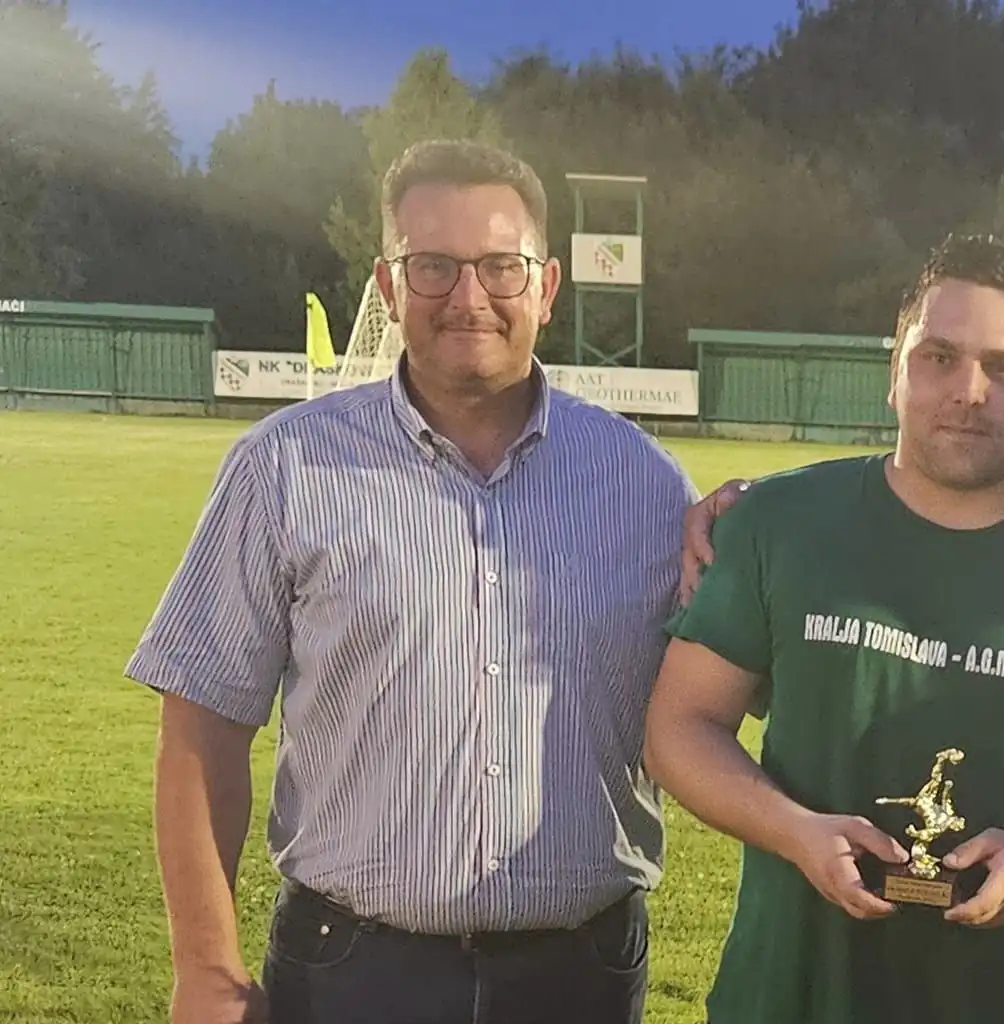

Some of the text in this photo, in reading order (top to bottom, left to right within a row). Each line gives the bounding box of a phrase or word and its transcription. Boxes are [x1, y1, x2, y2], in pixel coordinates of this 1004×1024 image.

[258, 359, 281, 373] NK
[803, 613, 861, 645] KRALJA
[863, 620, 948, 668] TOMISLAVA
